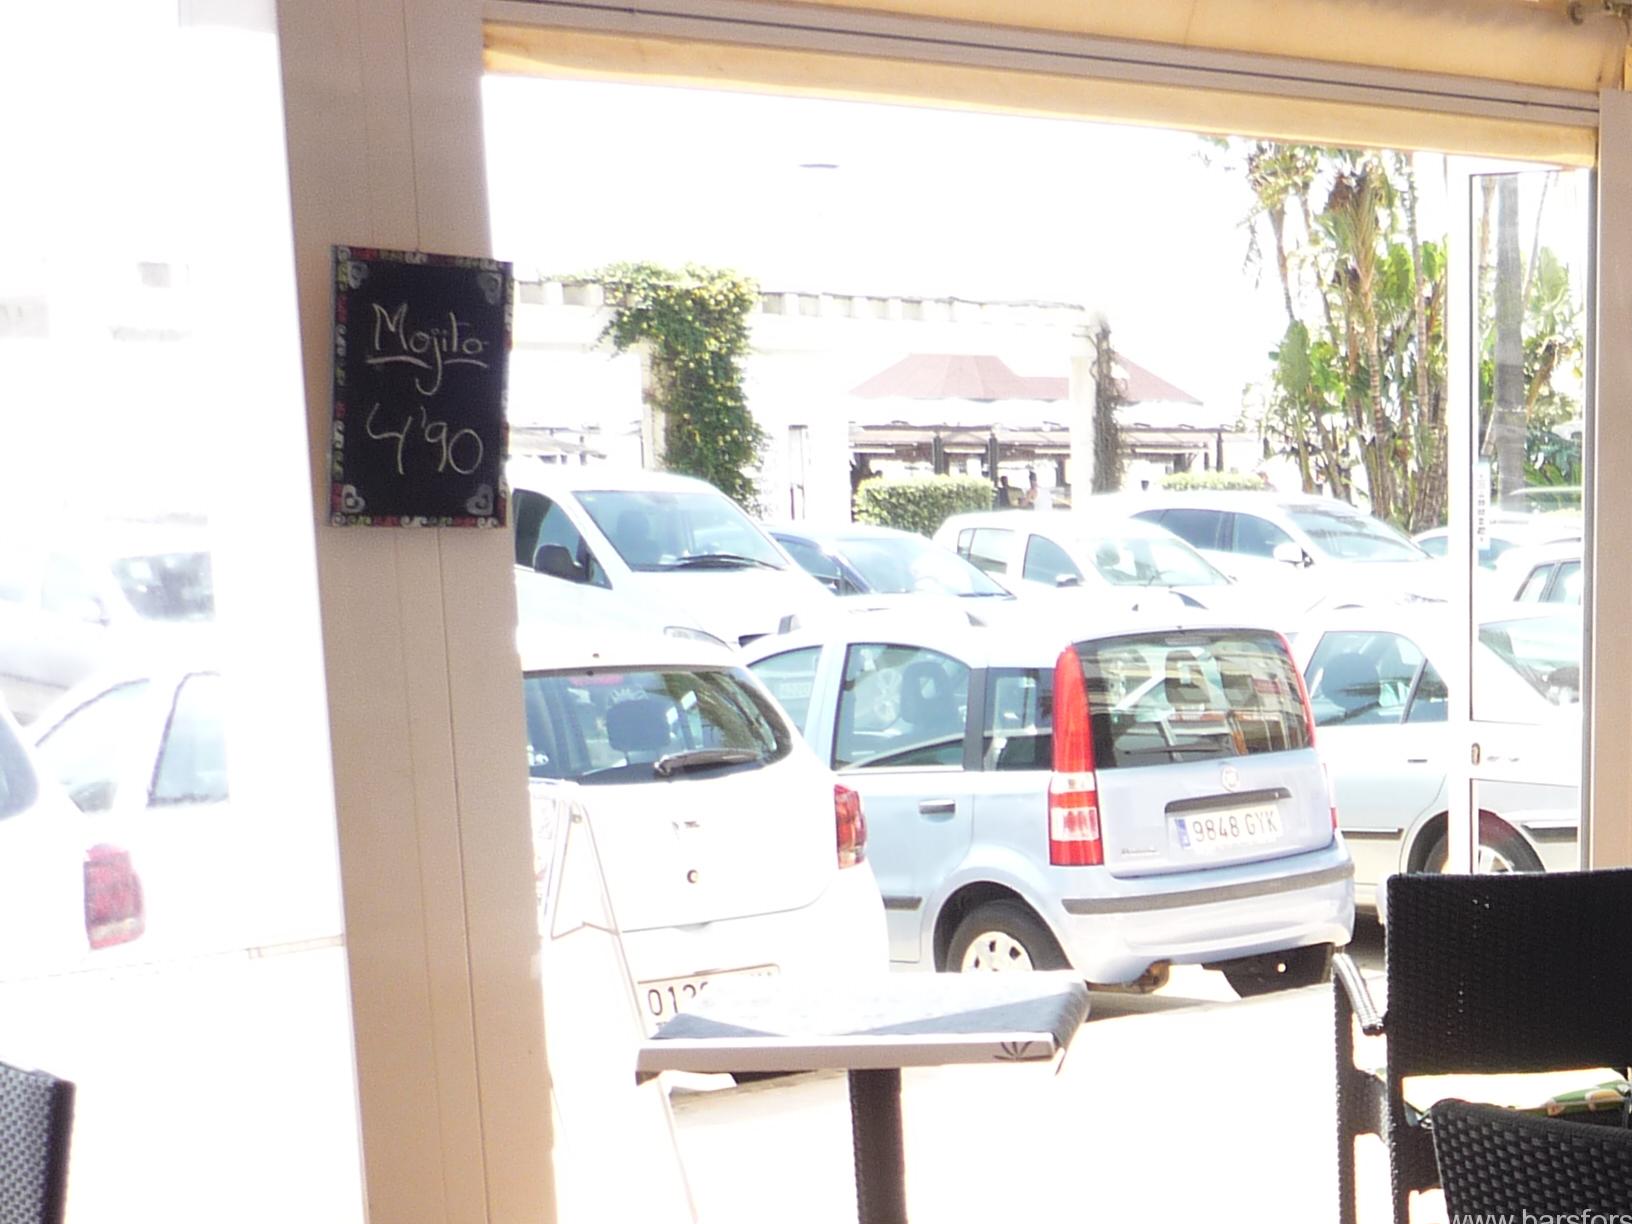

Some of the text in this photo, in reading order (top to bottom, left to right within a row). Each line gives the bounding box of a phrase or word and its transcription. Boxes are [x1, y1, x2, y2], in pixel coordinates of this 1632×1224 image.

[371, 302, 486, 396] Mojito
[1192, 810, 1278, 842] 9848 GYK
